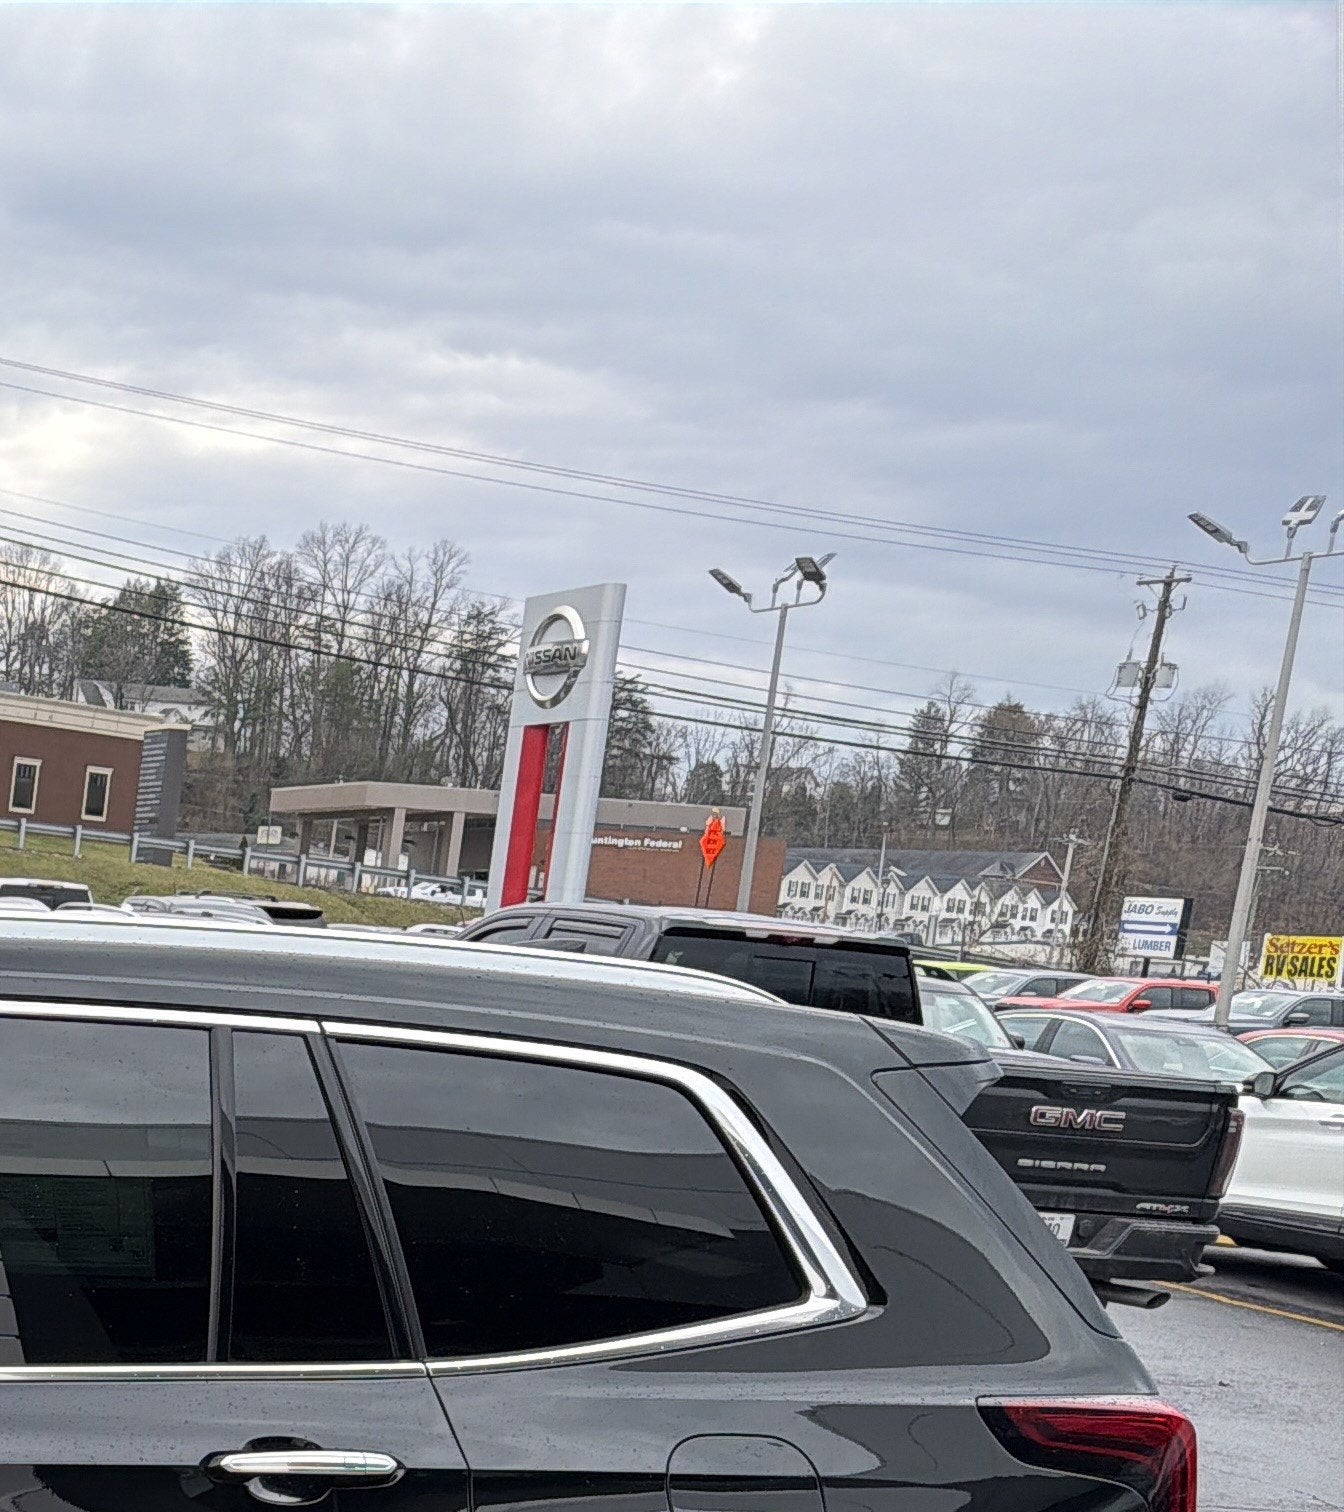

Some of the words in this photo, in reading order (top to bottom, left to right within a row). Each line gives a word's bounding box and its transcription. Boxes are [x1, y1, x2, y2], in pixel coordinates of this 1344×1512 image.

[591, 835, 641, 848] untington
[643, 837, 683, 849] Federal
[1124, 903, 1154, 915] JABO
[1132, 938, 1172, 952] LUMBER
[1266, 937, 1340, 956] Setzer's
[1263, 954, 1288, 976] RV
[1286, 956, 1337, 979] SALES
[1029, 1105, 1127, 1132] GMC
[1016, 1158, 1107, 1173] SIERRA
